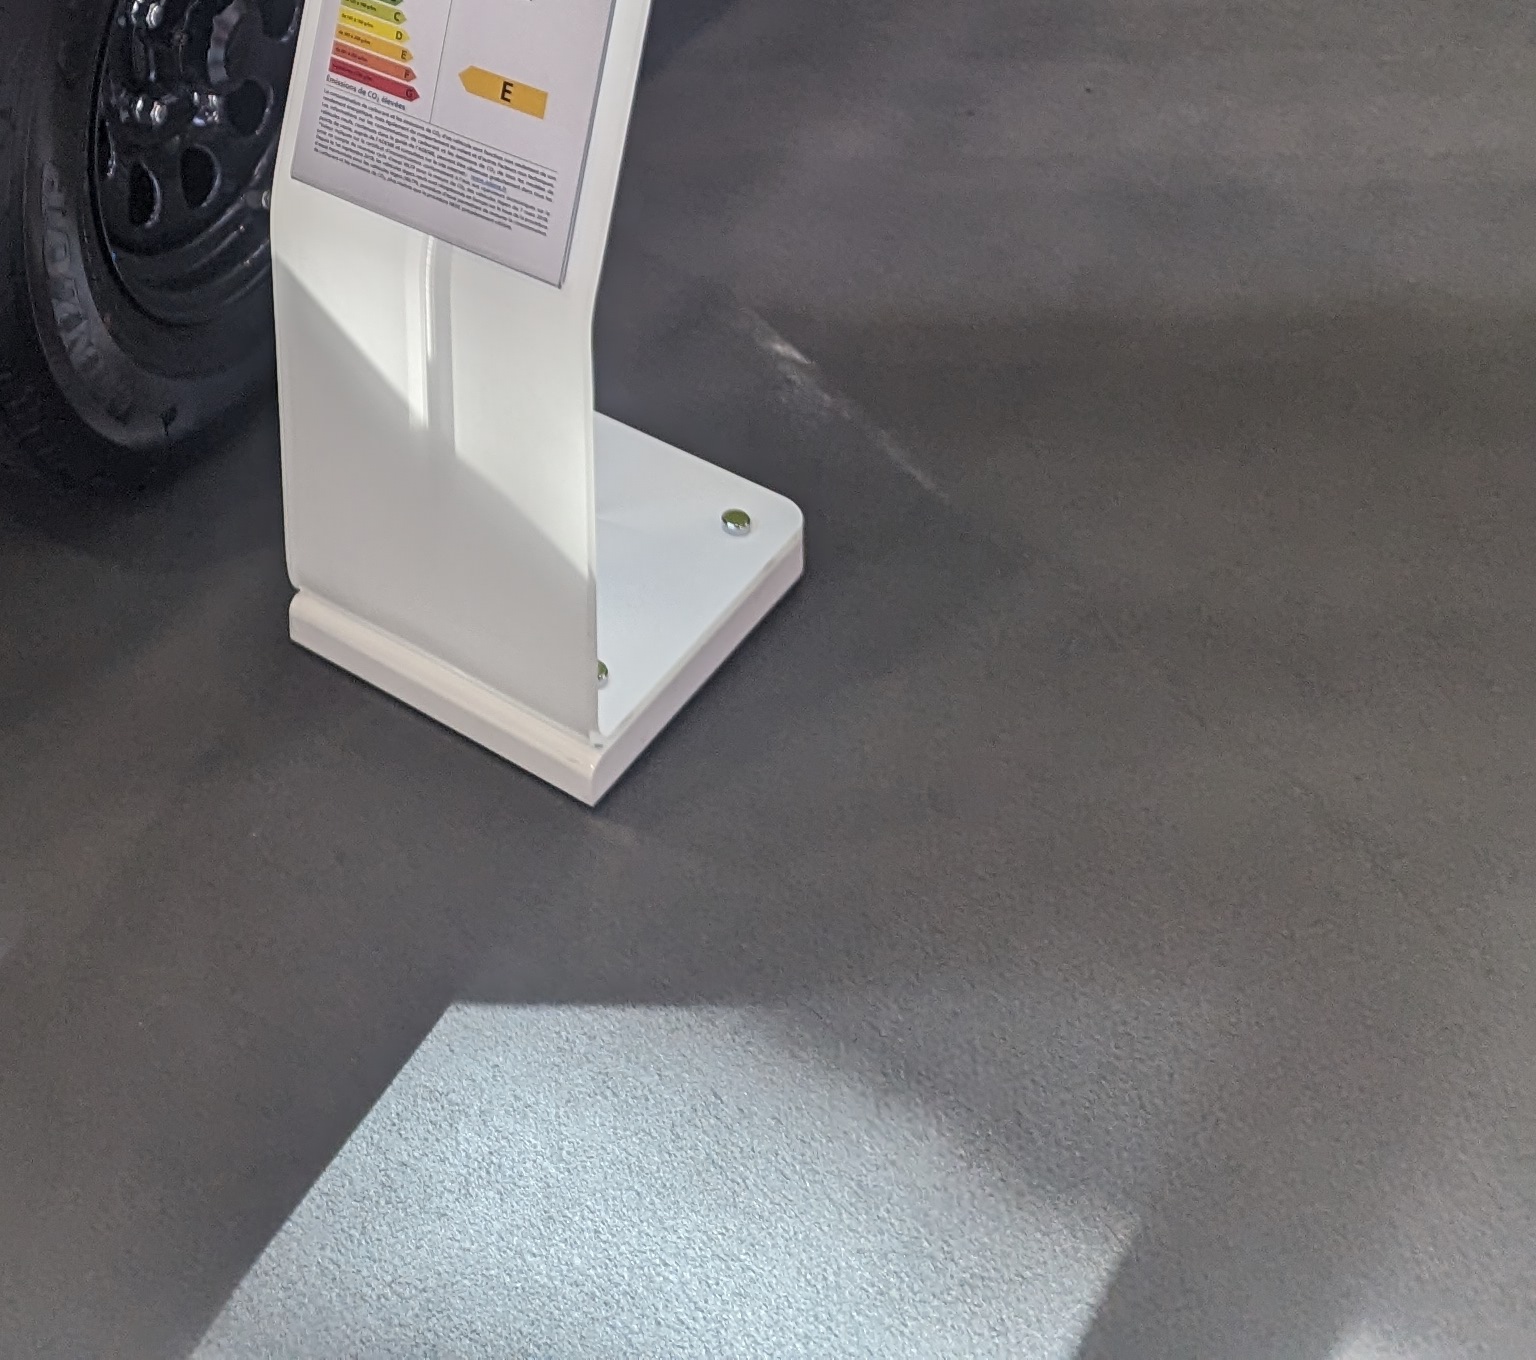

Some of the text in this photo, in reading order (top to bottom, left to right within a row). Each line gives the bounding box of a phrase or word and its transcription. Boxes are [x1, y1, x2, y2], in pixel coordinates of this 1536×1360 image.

[393, 11, 401, 22] C
[395, 30, 403, 40] D
[400, 49, 408, 60] E
[404, 68, 410, 79] F
[357, 86, 367, 97] de
[500, 80, 514, 103] E
